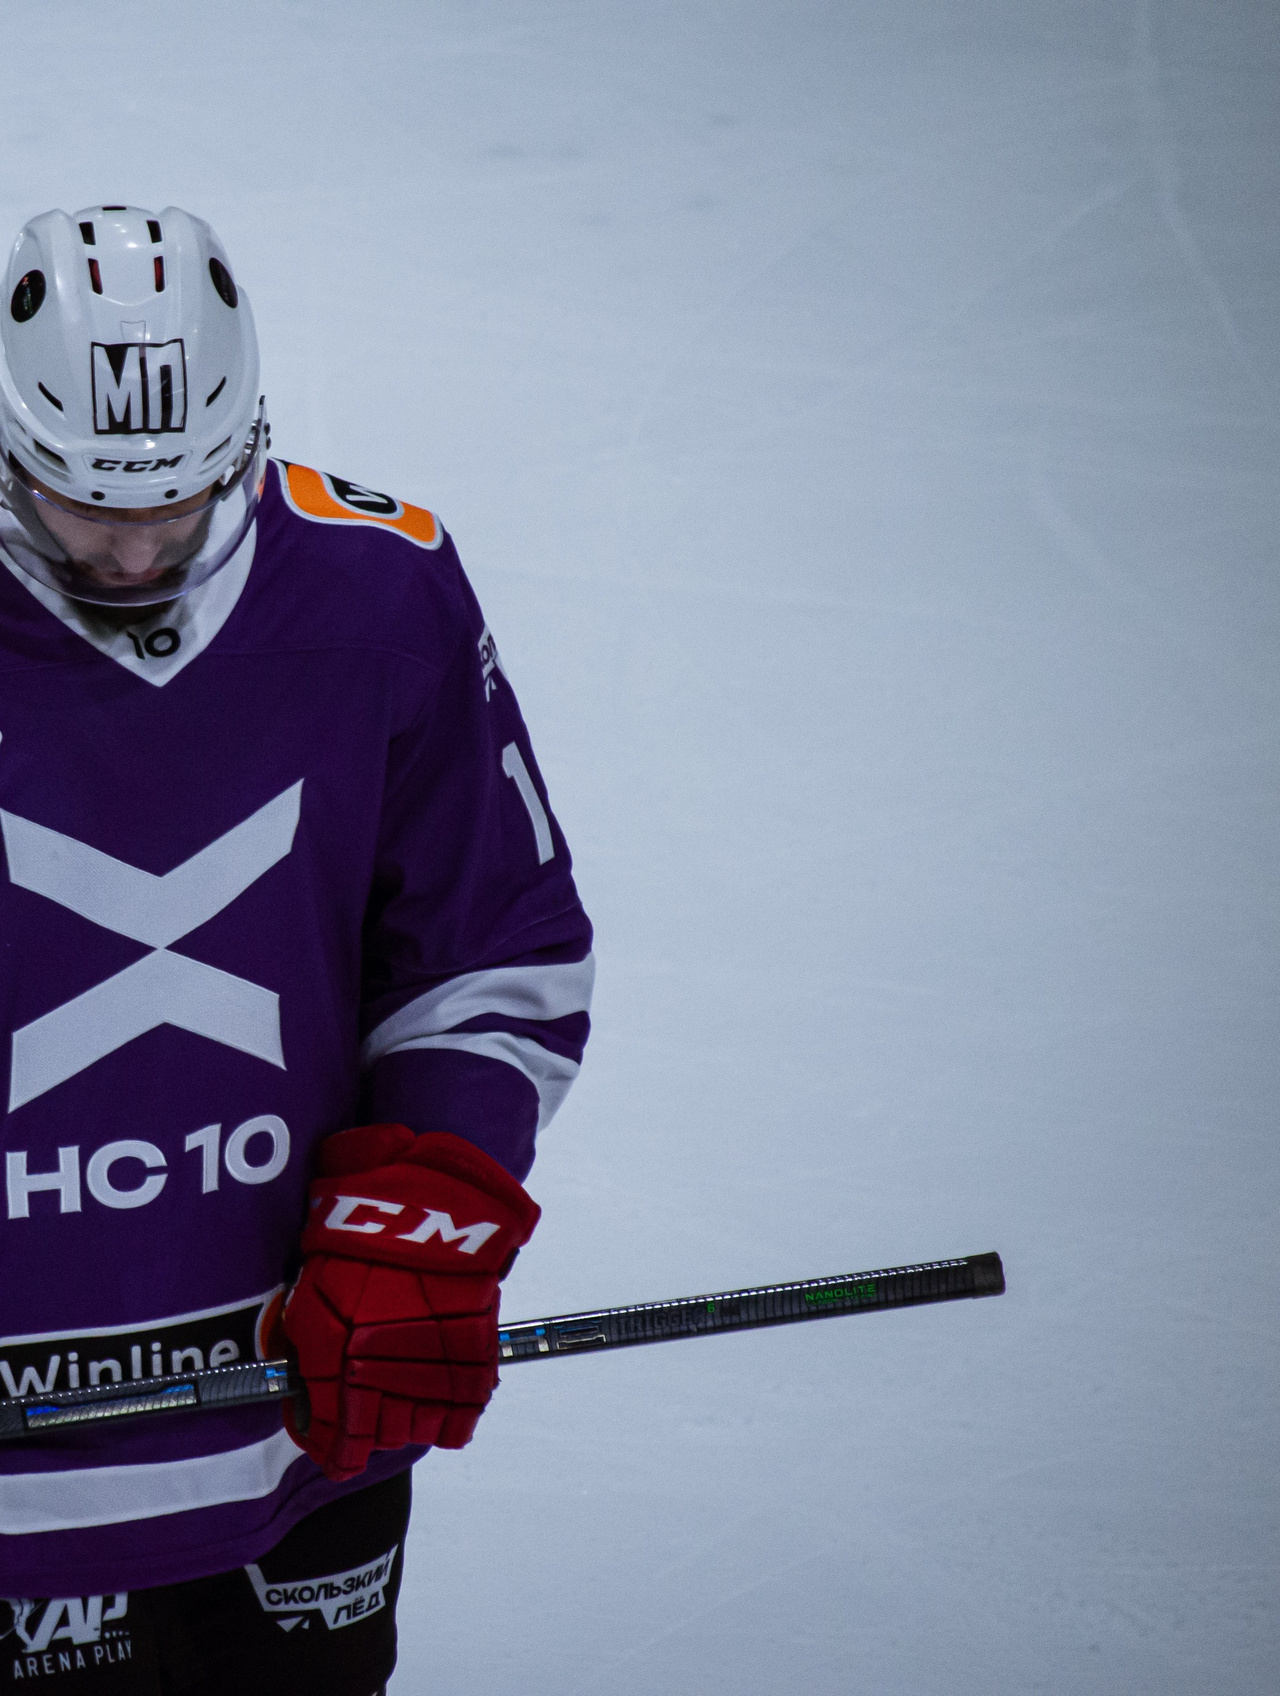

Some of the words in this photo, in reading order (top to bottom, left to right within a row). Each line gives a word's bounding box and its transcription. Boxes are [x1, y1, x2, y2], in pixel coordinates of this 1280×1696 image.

[91, 453, 183, 473] CCM
[126, 627, 181, 660] 10
[6, 1140, 168, 1219] HC
[185, 1114, 290, 1194] 10
[311, 1195, 501, 1255] CM
[805, 1283, 877, 1302] NANOLITE
[265, 1553, 390, 1606] СКОЛЬЗКИЙ
[333, 1590, 381, 1625] ЛЁД
[13, 1650, 86, 1680] ARENA
[94, 1639, 132, 1665] PLAY
